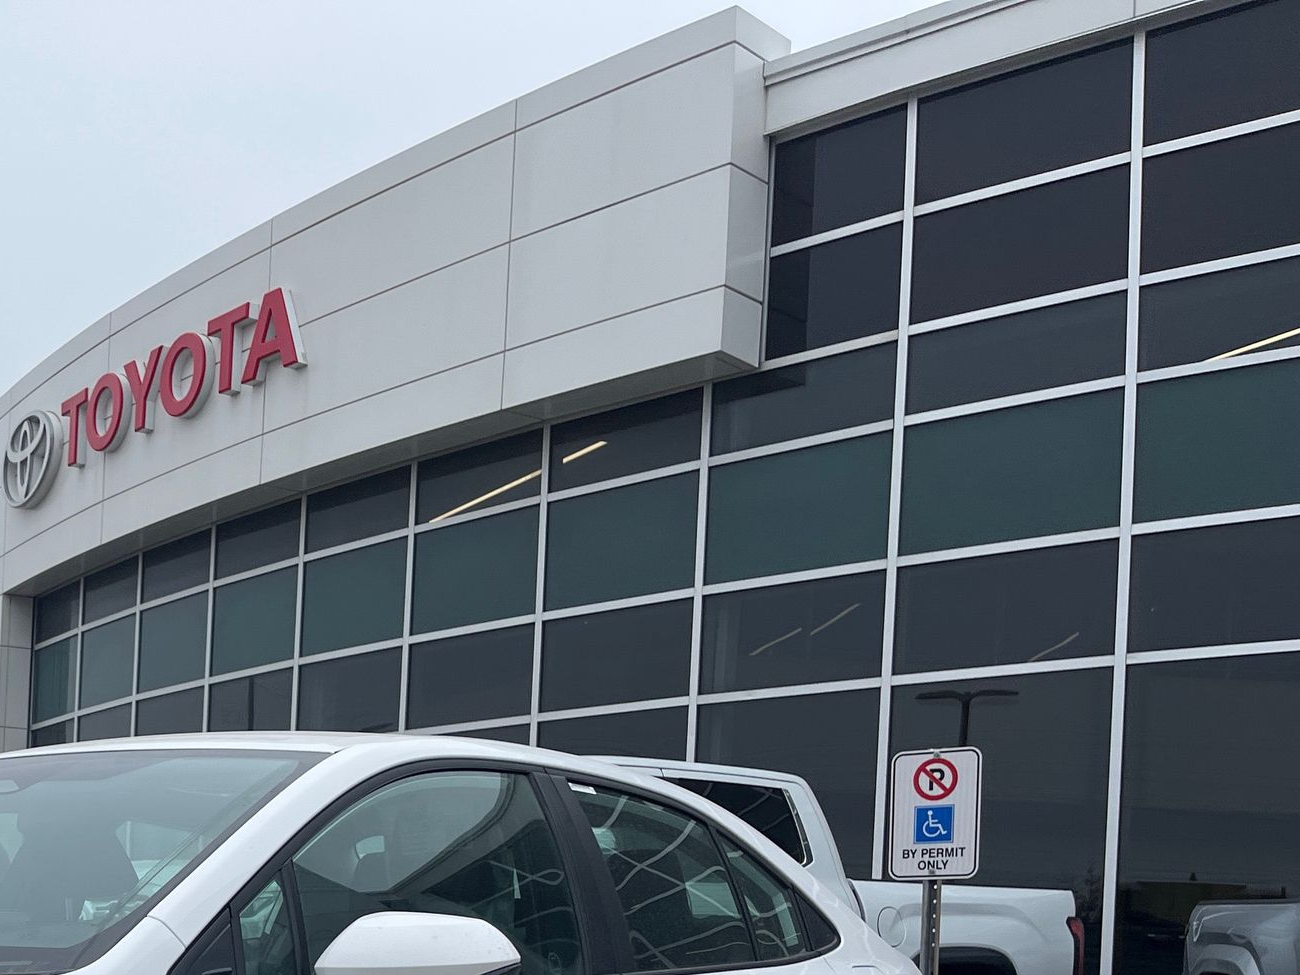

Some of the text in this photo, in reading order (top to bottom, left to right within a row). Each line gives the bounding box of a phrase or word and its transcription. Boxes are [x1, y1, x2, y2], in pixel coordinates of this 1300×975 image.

[61, 287, 305, 468] TOYOTA
[902, 847, 966, 859] BY PERMIT
[917, 860, 949, 871] ONLY
